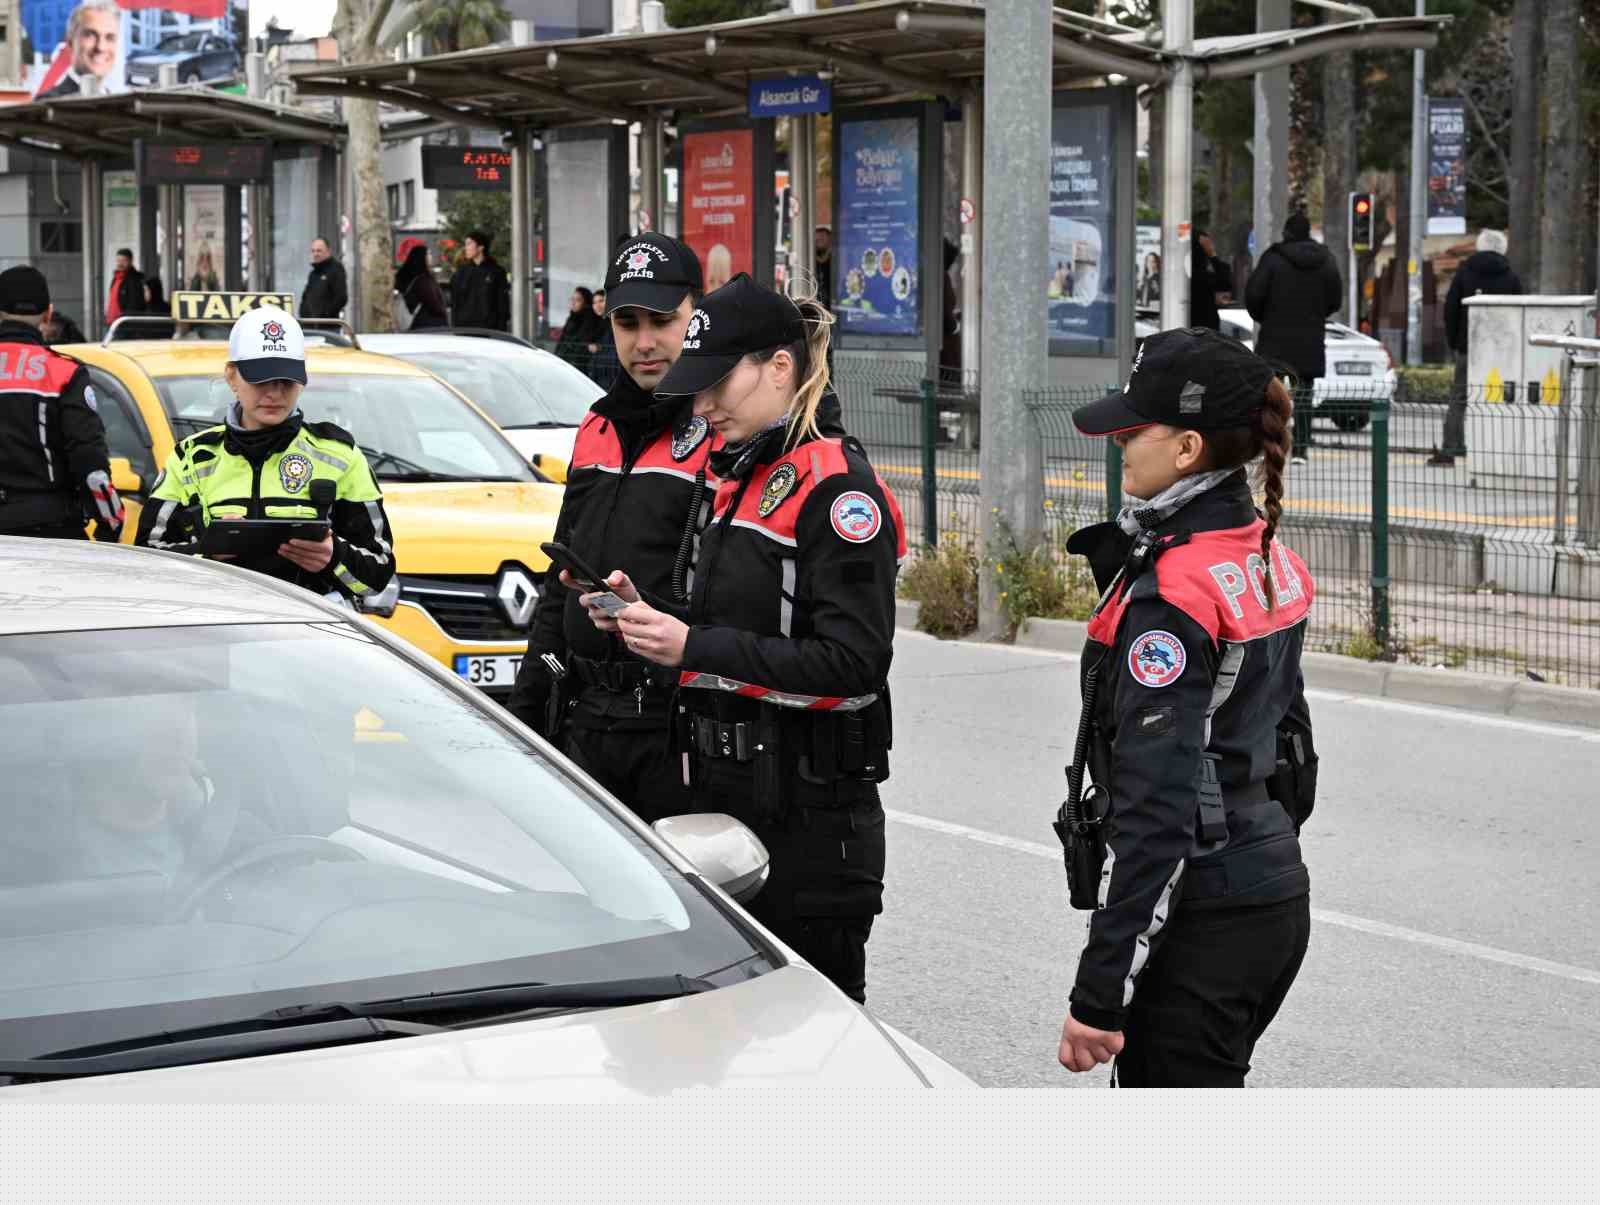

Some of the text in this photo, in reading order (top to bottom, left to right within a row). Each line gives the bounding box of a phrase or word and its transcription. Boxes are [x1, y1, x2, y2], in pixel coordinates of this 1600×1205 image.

[802, 86, 821, 104] Gar
[619, 268, 655, 282] POLİS
[261, 343, 288, 352] POLİS
[0, 348, 48, 381] LİS
[470, 659, 496, 683] 35
